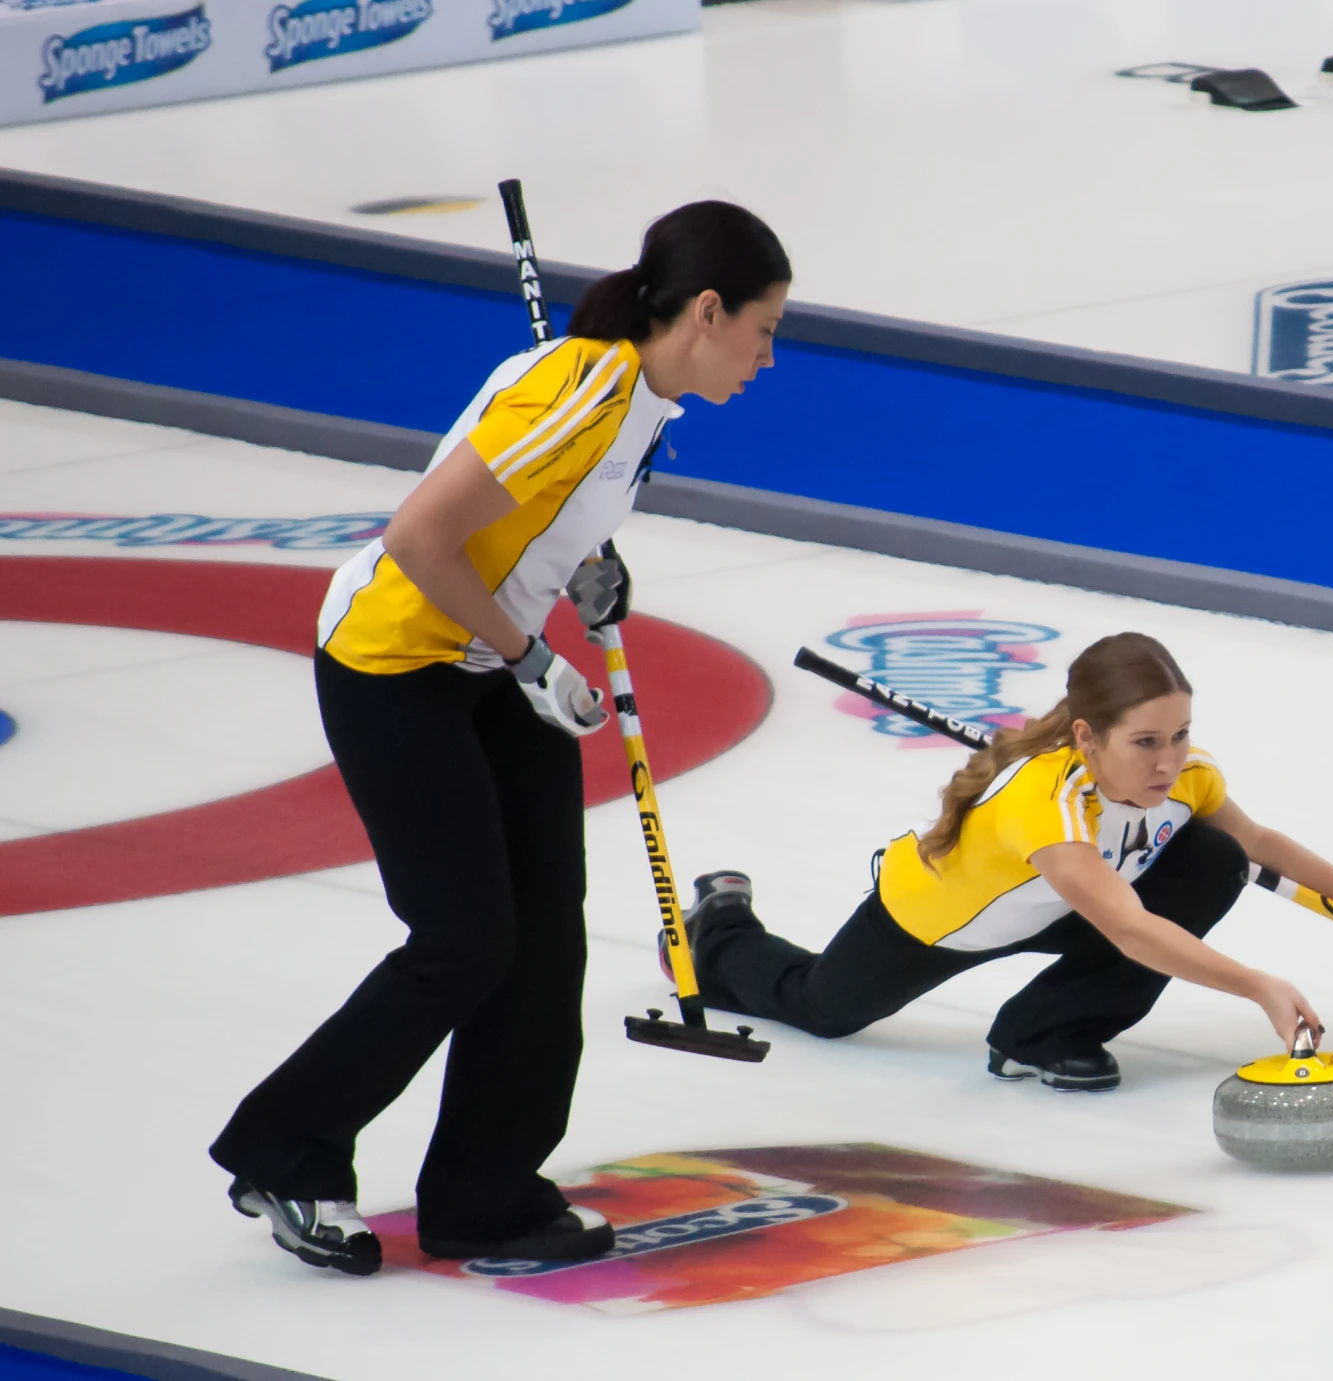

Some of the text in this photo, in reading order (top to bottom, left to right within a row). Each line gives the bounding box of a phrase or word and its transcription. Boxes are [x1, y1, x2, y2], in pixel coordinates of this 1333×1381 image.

[40, 16, 211, 89] Sponge Towels
[265, 6, 356, 60] Sponge
[639, 811, 680, 947] Goldline
